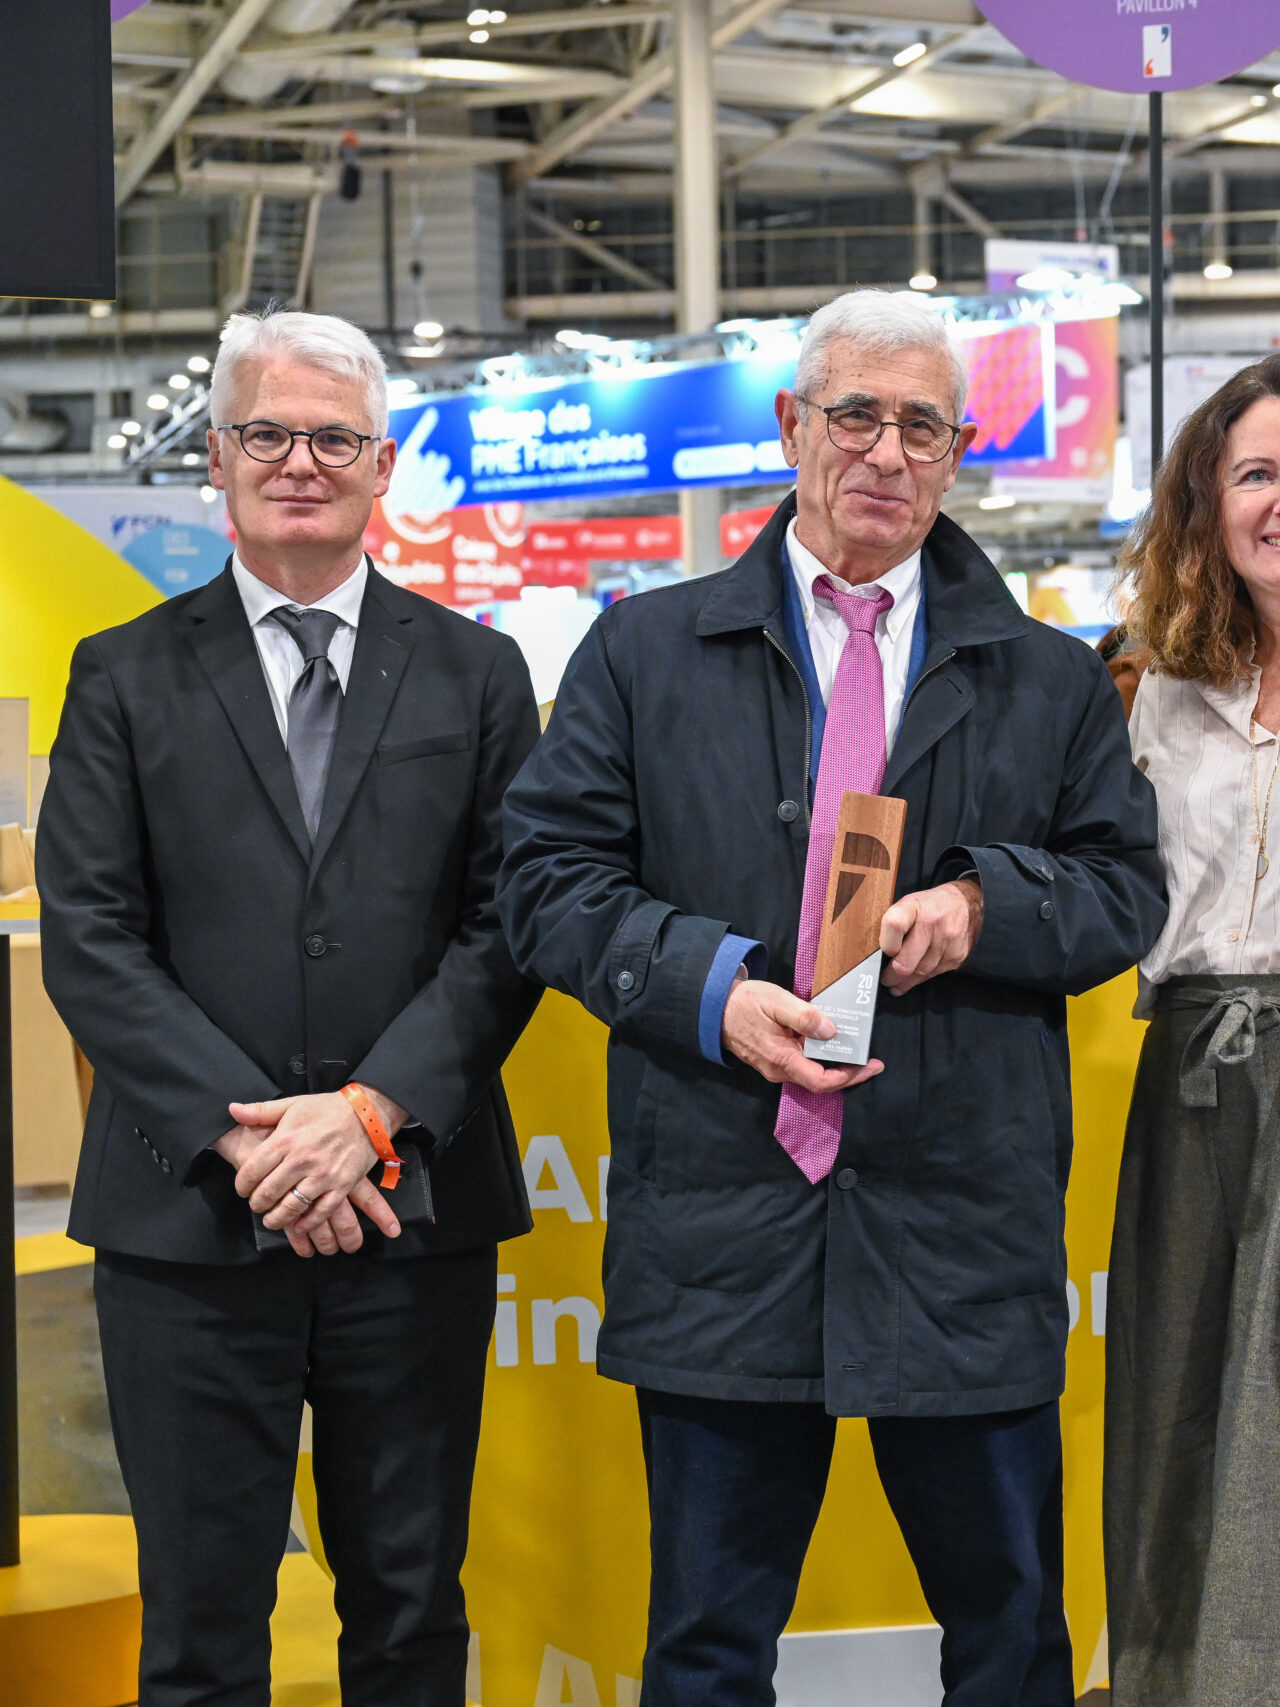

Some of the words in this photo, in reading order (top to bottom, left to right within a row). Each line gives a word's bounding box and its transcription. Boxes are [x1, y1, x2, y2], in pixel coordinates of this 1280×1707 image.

[858, 973, 873, 990] 20
[856, 989, 871, 1005] 25
[522, 1135, 611, 1223] A
